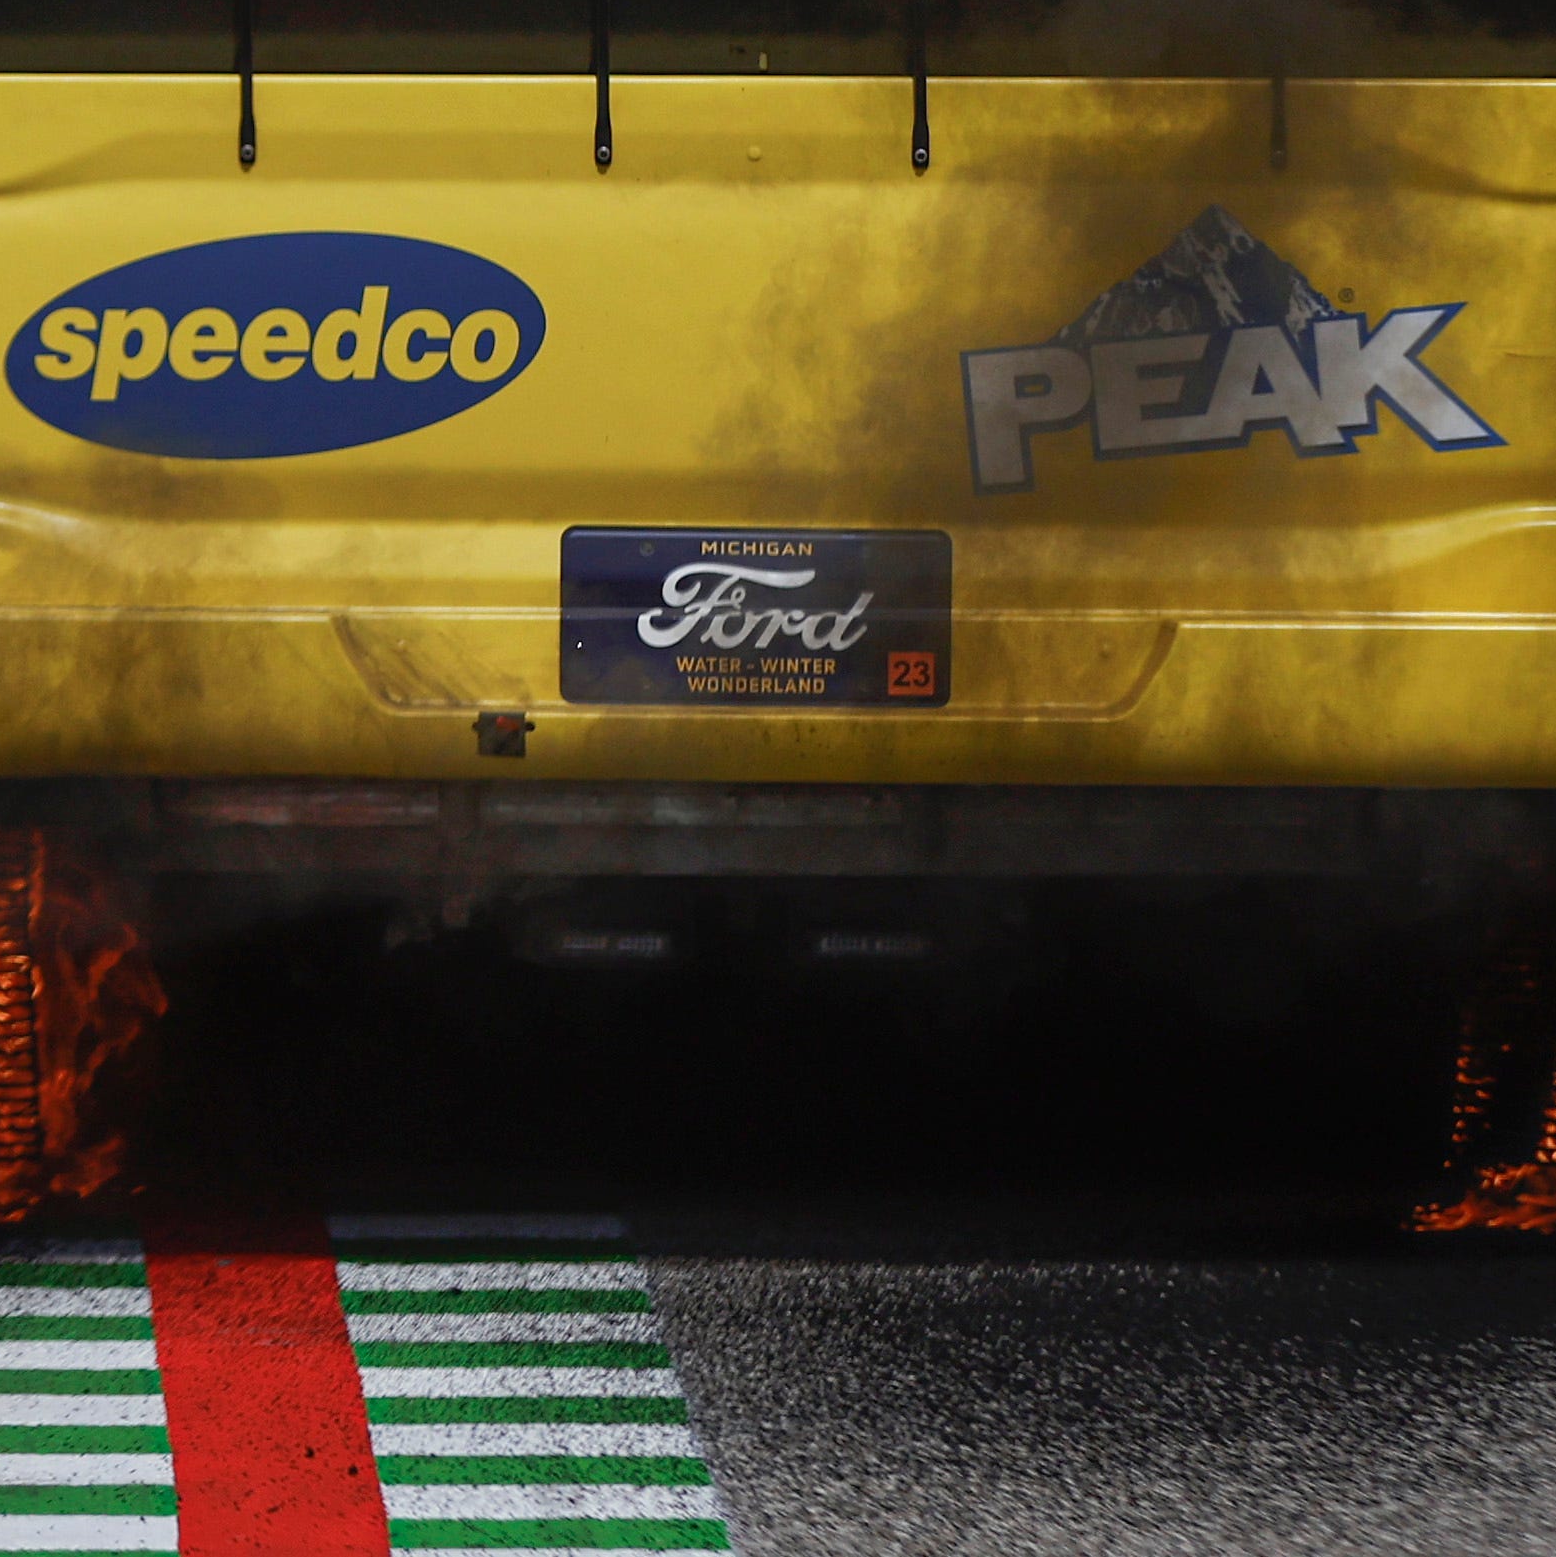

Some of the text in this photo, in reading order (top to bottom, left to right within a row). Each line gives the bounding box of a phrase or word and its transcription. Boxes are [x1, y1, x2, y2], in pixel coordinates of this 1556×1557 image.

[32, 284, 521, 402] speedco
[960, 301, 1508, 496] PEAK
[700, 539, 814, 557] MICHIGAN
[636, 561, 875, 652] Ford
[676, 656, 742, 675] WATER
[760, 656, 837, 676] WINTER
[892, 660, 932, 688] 23
[687, 676, 826, 695] WONDERLAND
